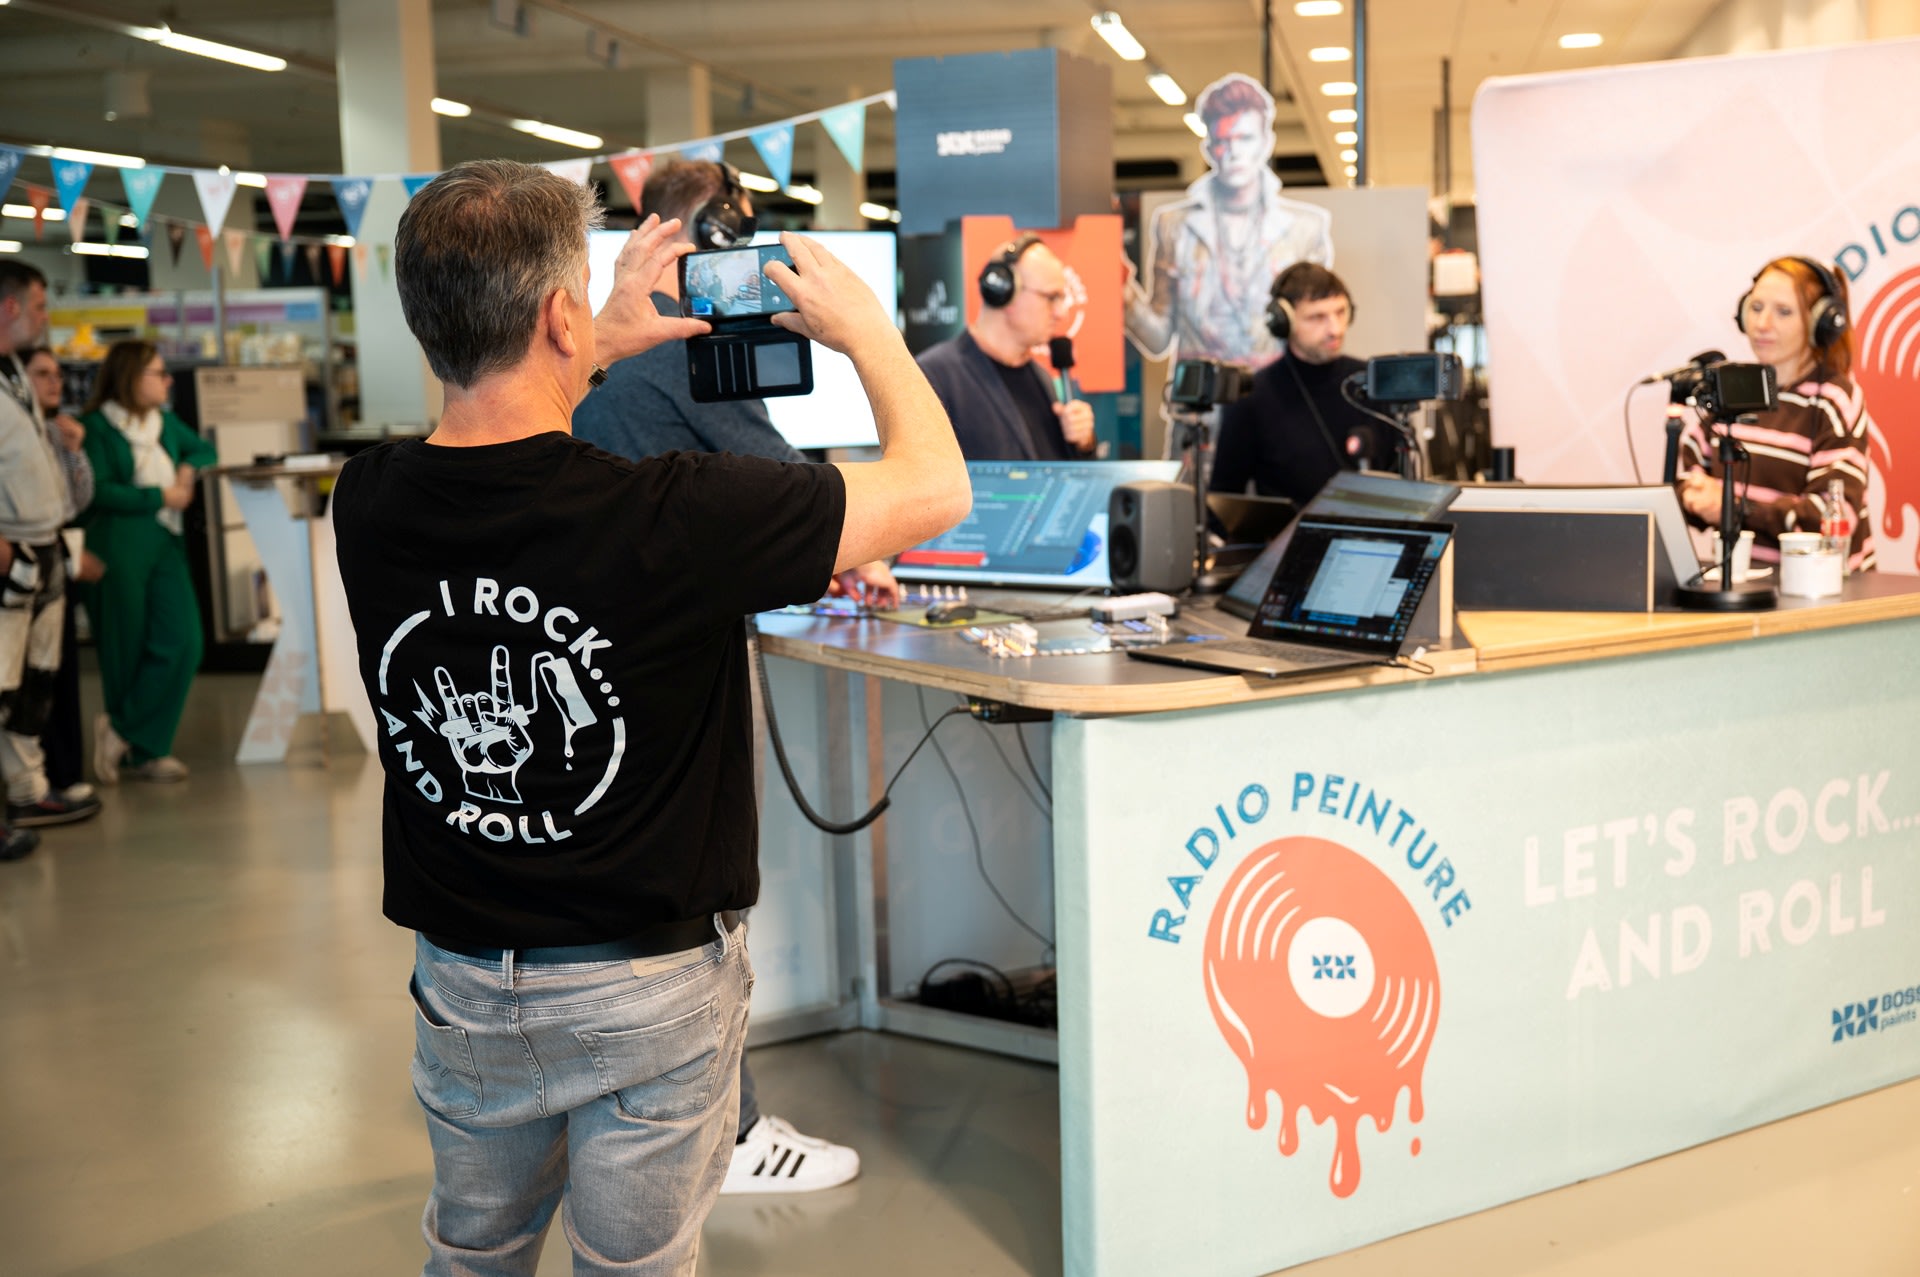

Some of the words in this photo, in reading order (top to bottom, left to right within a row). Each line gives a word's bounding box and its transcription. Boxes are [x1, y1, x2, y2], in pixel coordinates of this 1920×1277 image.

[1834, 206, 1920, 282] DIO
[439, 579, 456, 618] I
[473, 577, 621, 707] ROCK...
[379, 706, 444, 803] AND
[445, 800, 574, 845] ROLL
[1147, 783, 1270, 944] RADIO
[1291, 771, 1472, 928] PEINTURE
[1524, 806, 1698, 908] LET'S
[1564, 903, 1713, 1000] AND
[1738, 864, 1888, 960] ROLL
